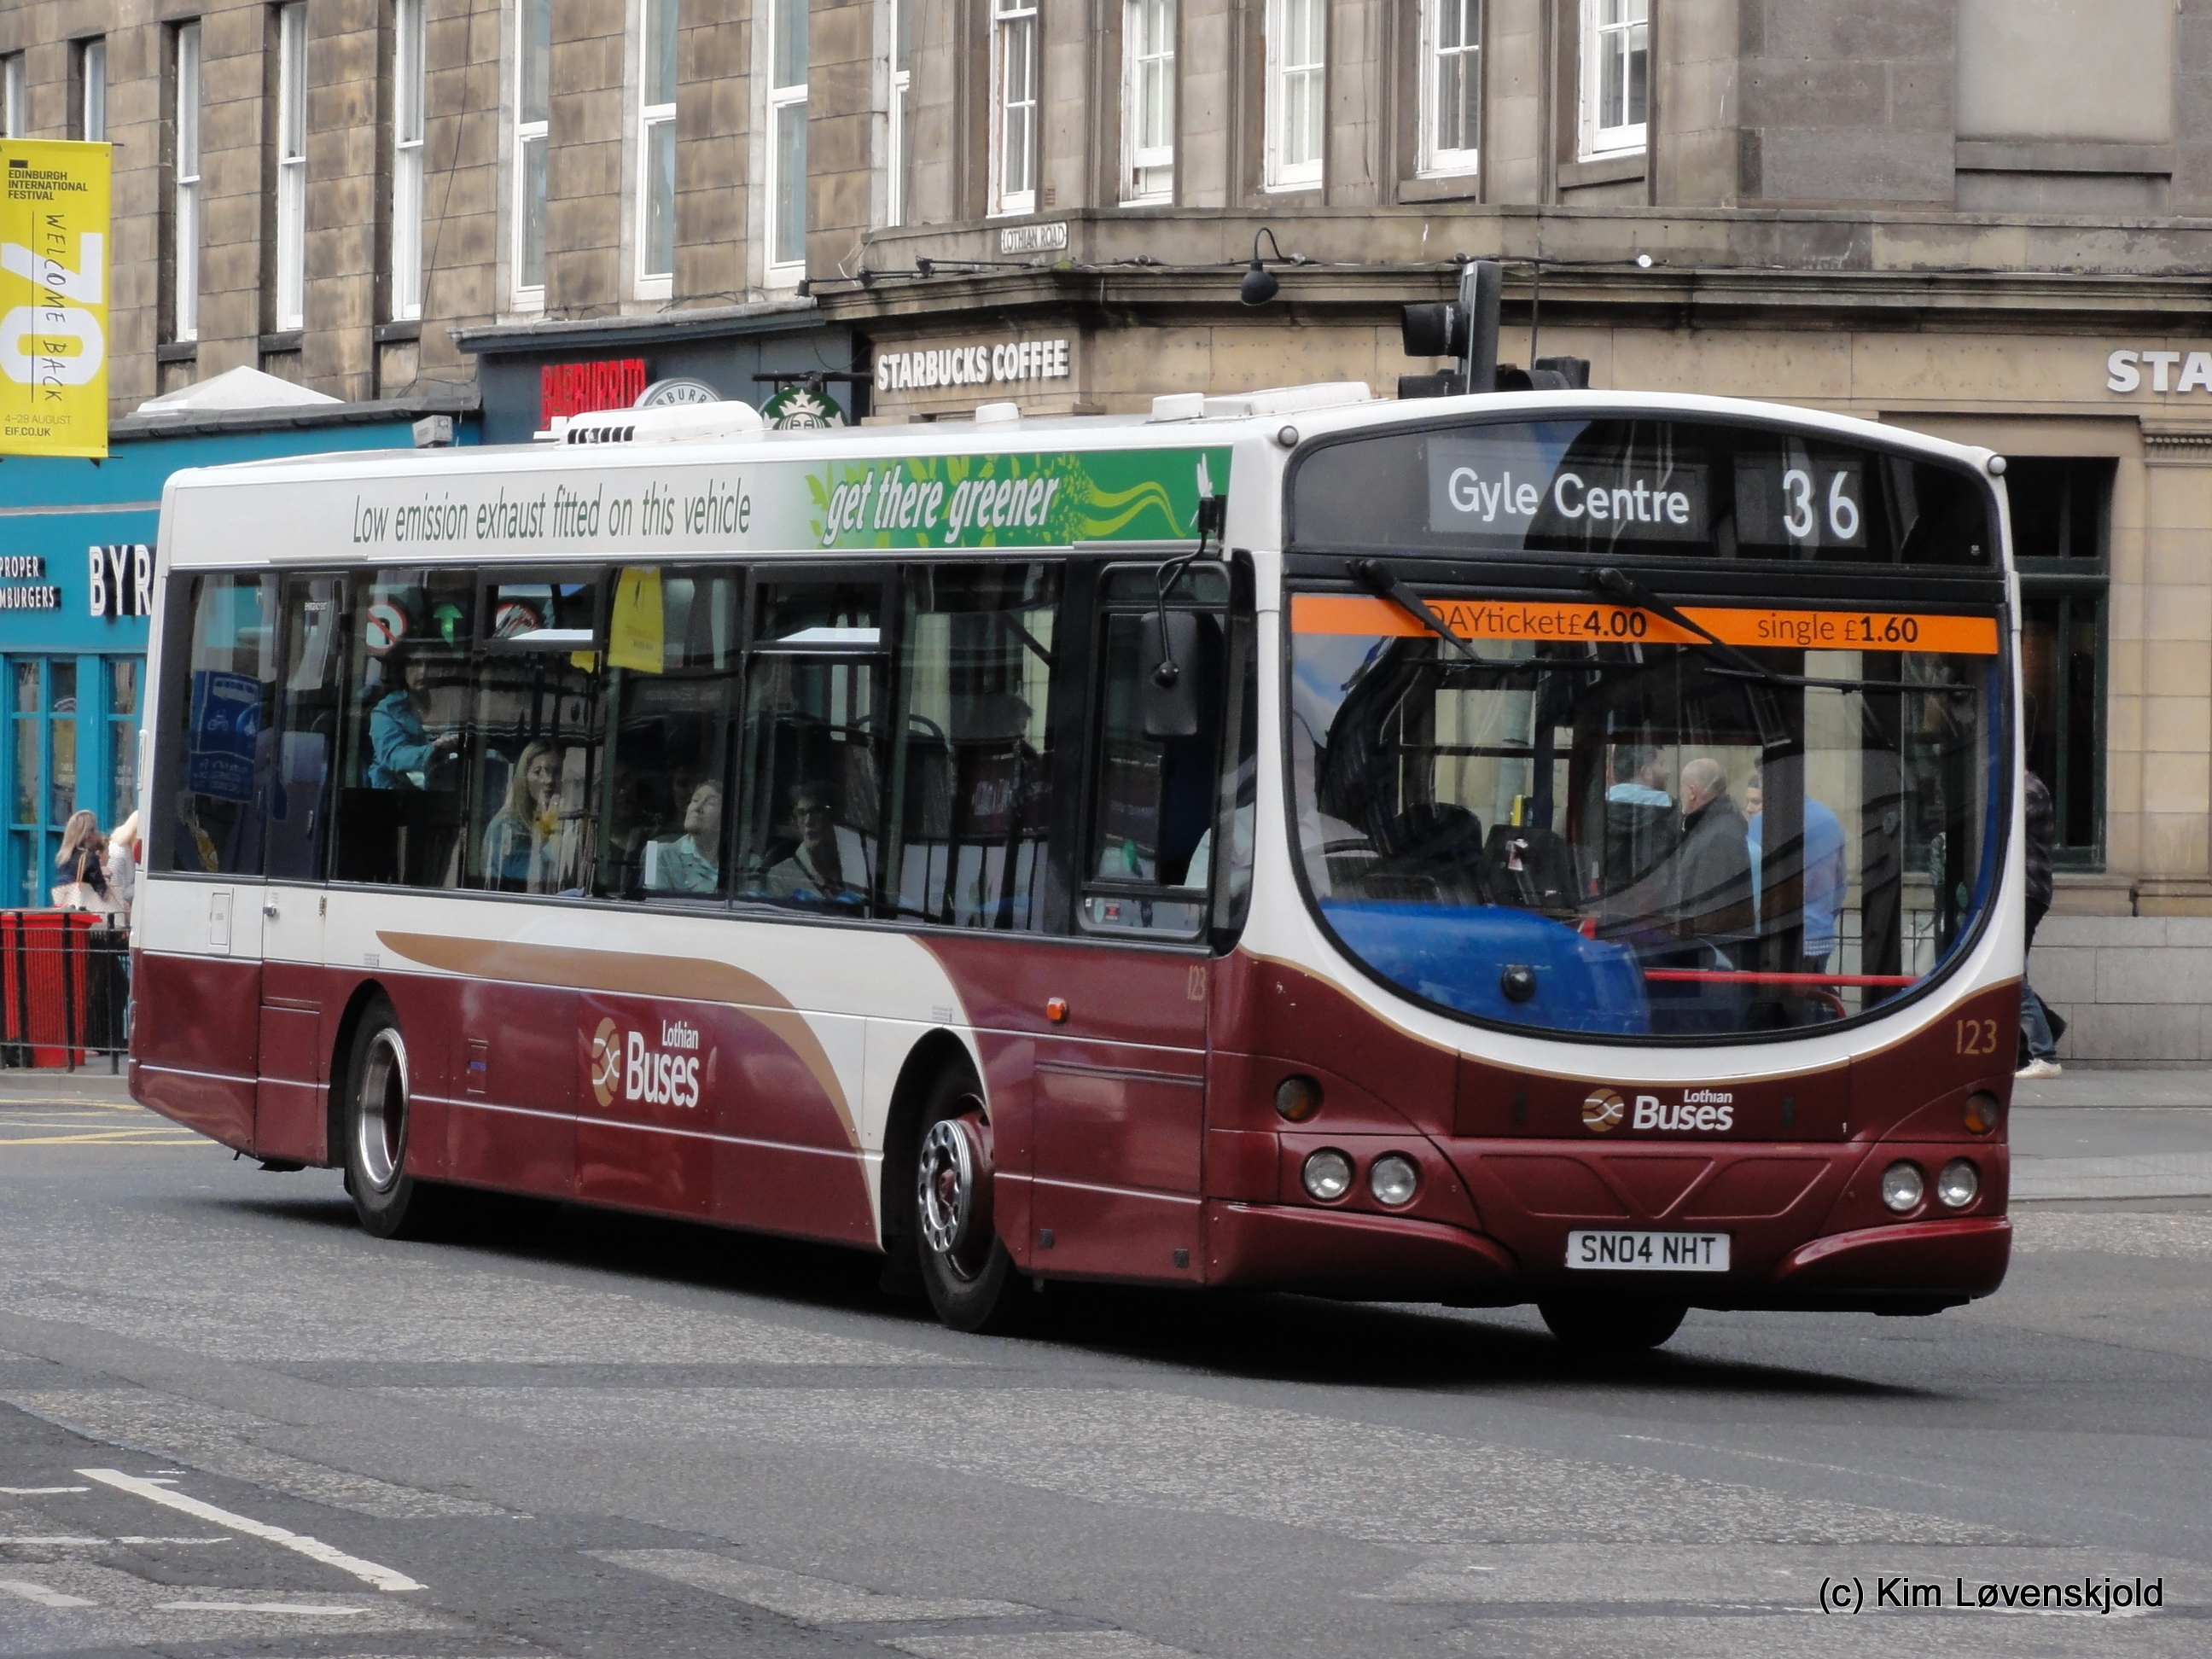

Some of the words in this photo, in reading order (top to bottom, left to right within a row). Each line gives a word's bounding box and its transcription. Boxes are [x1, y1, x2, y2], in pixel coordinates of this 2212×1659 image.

[8, 179, 88, 192] INTERNATIONAL
[9, 170, 67, 181] EDINBURGH
[8, 189, 55, 201] FESTIVAL
[1003, 228, 1038, 251] LOTHIAN
[1041, 225, 1065, 247] ROAD
[41, 213, 67, 323] WELCOME
[42, 340, 67, 402] BACK
[878, 346, 988, 391] STARBUCKS
[992, 339, 1068, 381] COFFEE
[2107, 350, 2212, 392] STA
[5, 427, 51, 437] EIF.CO.UK
[32, 415, 72, 425] AUGUST
[353, 494, 389, 543] Low
[395, 492, 468, 541] emission
[476, 486, 545, 539] exhaust
[552, 483, 602, 538] fitted
[608, 498, 632, 537] on
[642, 480, 675, 536] this
[684, 477, 751, 535] vehicle
[822, 468, 871, 545] get
[873, 464, 943, 530] there
[944, 476, 1060, 544] greener
[1448, 467, 1539, 522] Gyle
[1554, 473, 1690, 524] Centre
[1783, 469, 1859, 539] 36
[0, 556, 38, 578] PROPER
[89, 544, 151, 616] BYR
[1757, 613, 1835, 645] single
[1844, 615, 1918, 643] £1.60
[662, 1019, 699, 1050] Lothian
[1956, 1019, 1997, 1055] 123
[626, 1031, 699, 1108] Buses
[1684, 1089, 1732, 1103] Lothian
[1633, 1096, 1734, 1131] Buses
[1581, 1235, 1652, 1262] SN04
[1663, 1237, 1715, 1264] NHT
